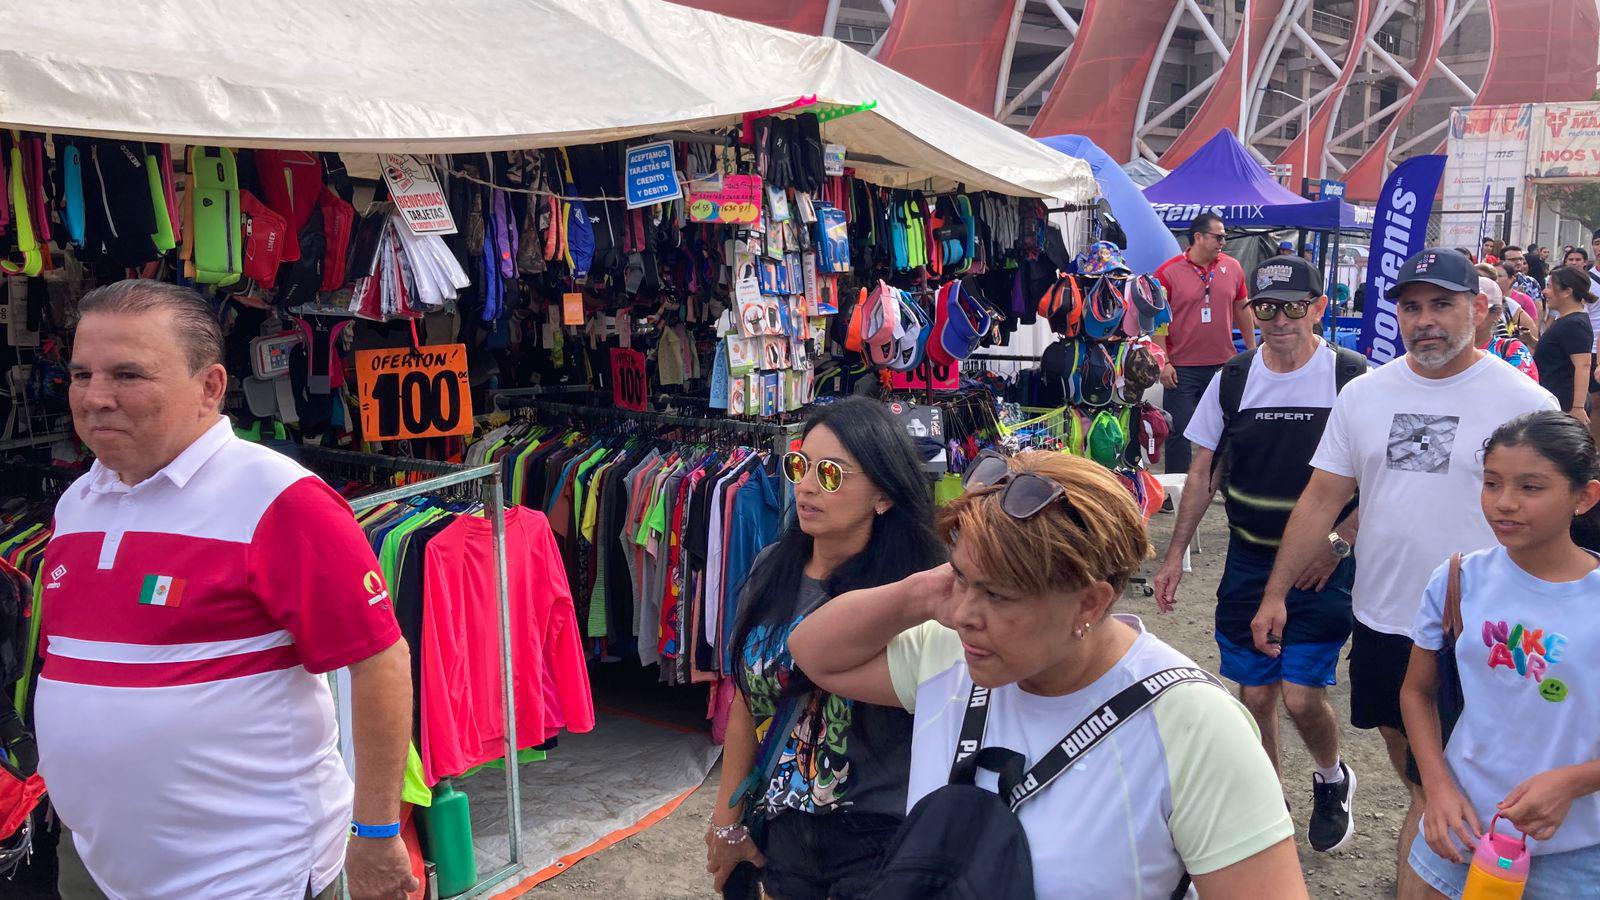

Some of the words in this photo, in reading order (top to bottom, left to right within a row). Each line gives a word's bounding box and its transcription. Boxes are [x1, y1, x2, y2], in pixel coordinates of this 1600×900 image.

[1570, 115, 1600, 129] MA
[630, 149, 668, 164] ACEPTAMOS
[629, 163, 660, 176] TARJETAS
[661, 160, 671, 169] DE
[636, 173, 665, 186] CREDITO
[637, 190, 642, 198] Y
[643, 185, 669, 197] DEBITO
[396, 192, 444, 209] BIENVENIDAS
[407, 207, 445, 221] TARJETAS
[1366, 187, 1417, 371] portenis
[372, 370, 461, 437] 100
[1255, 412, 1314, 421] REPEAT
[1481, 620, 1569, 664] NIKE
[1487, 642, 1548, 684] AIR
[1142, 666, 1209, 696] PUMA
[1060, 705, 1119, 759] PUMA
[1010, 772, 1039, 808] PU
